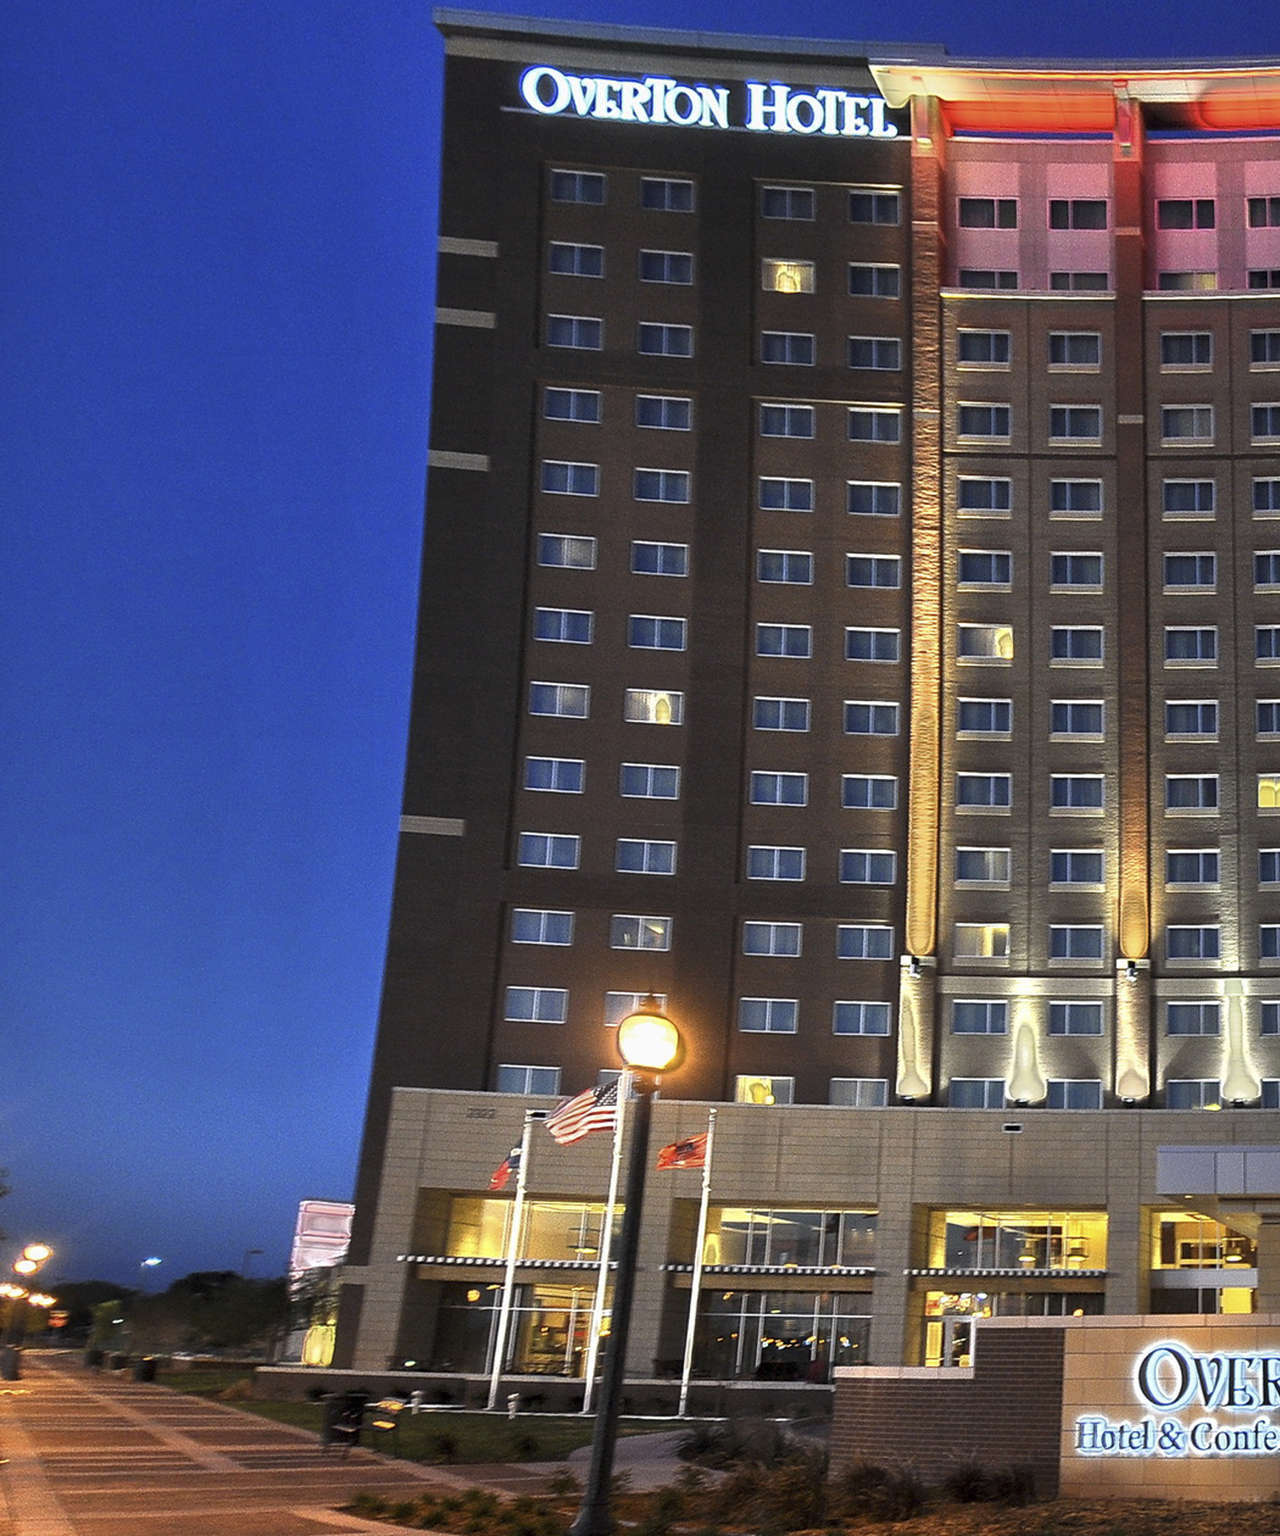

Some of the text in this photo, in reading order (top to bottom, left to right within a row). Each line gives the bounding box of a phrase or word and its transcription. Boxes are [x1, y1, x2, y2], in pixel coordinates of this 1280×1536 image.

[520, 66, 897, 138] OVERTON HOTEL
[1076, 1420, 1150, 1450] Hotel
[1158, 1421, 1186, 1451] &
